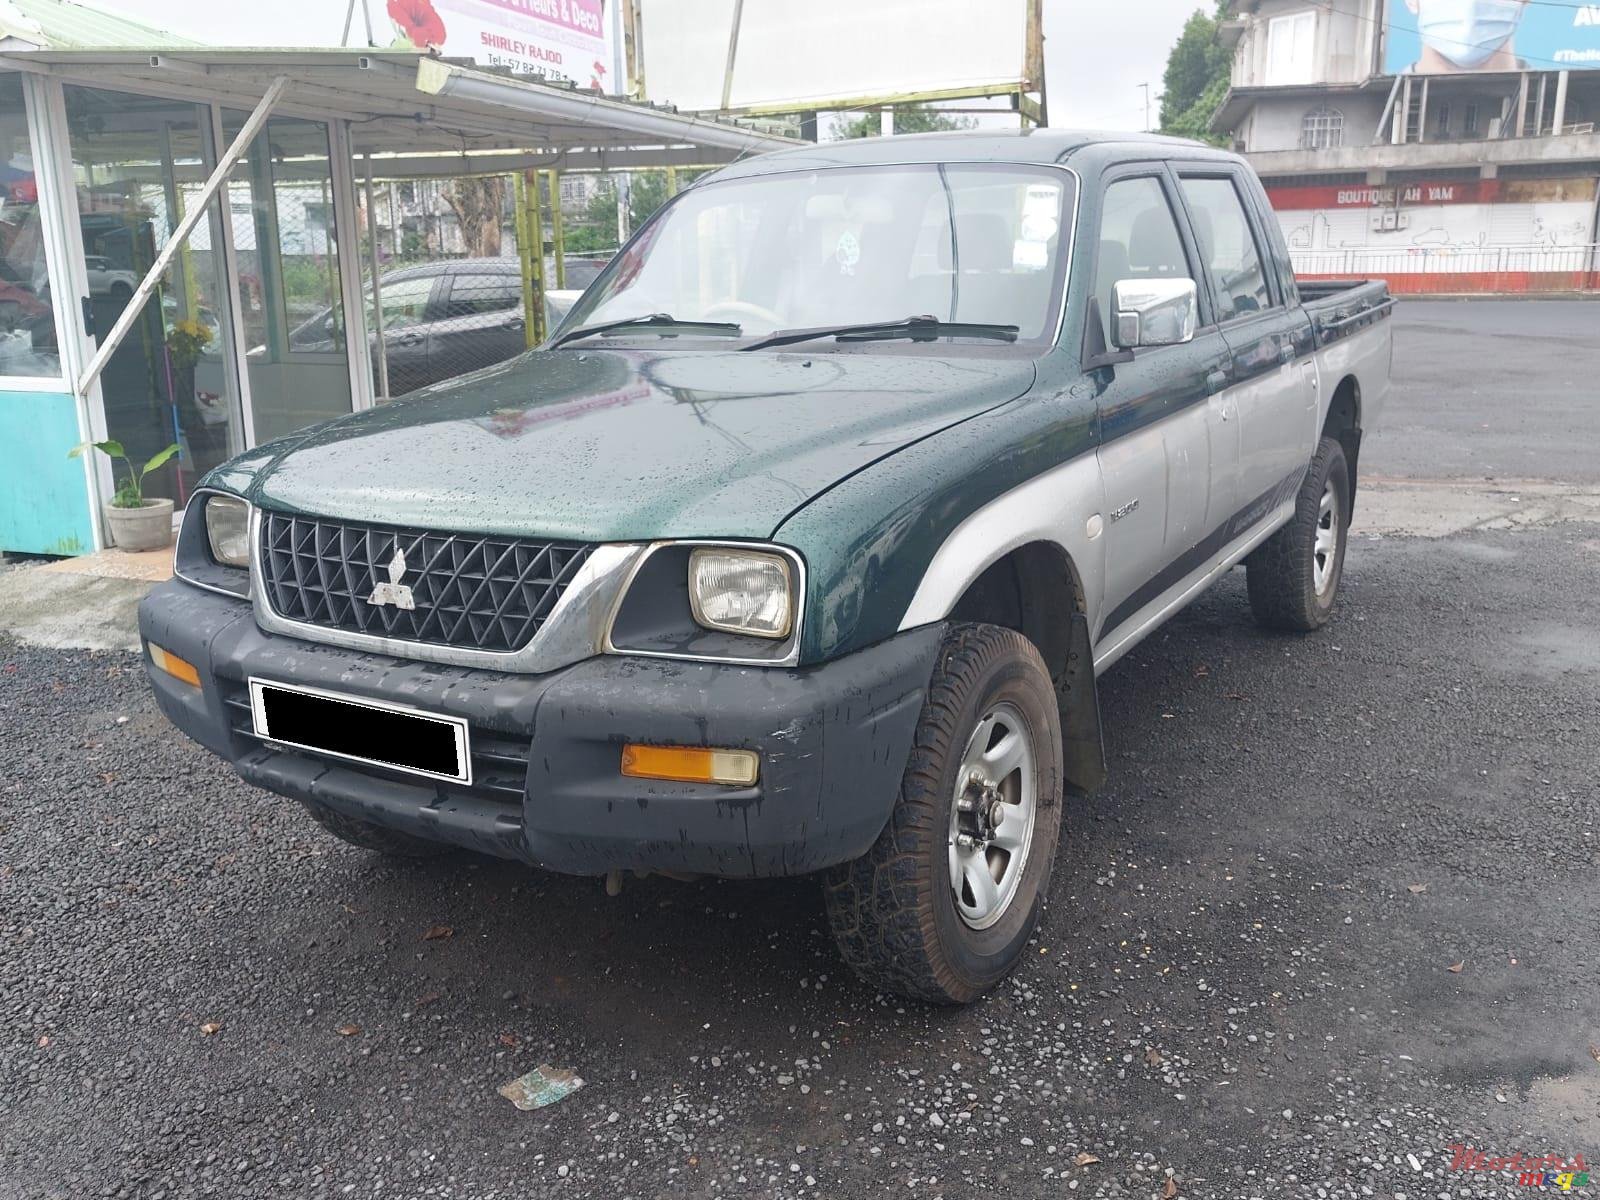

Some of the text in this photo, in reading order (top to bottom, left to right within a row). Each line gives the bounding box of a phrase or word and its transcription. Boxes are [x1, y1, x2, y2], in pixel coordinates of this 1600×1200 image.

[560, 0, 570, 22] &
[480, 31, 527, 55] SHIRLEY
[508, 58, 520, 70] 57
[522, 62, 535, 74] 82
[549, 69, 561, 81] 78
[1337, 186, 1454, 204] BOUTIQUE AH YAM
